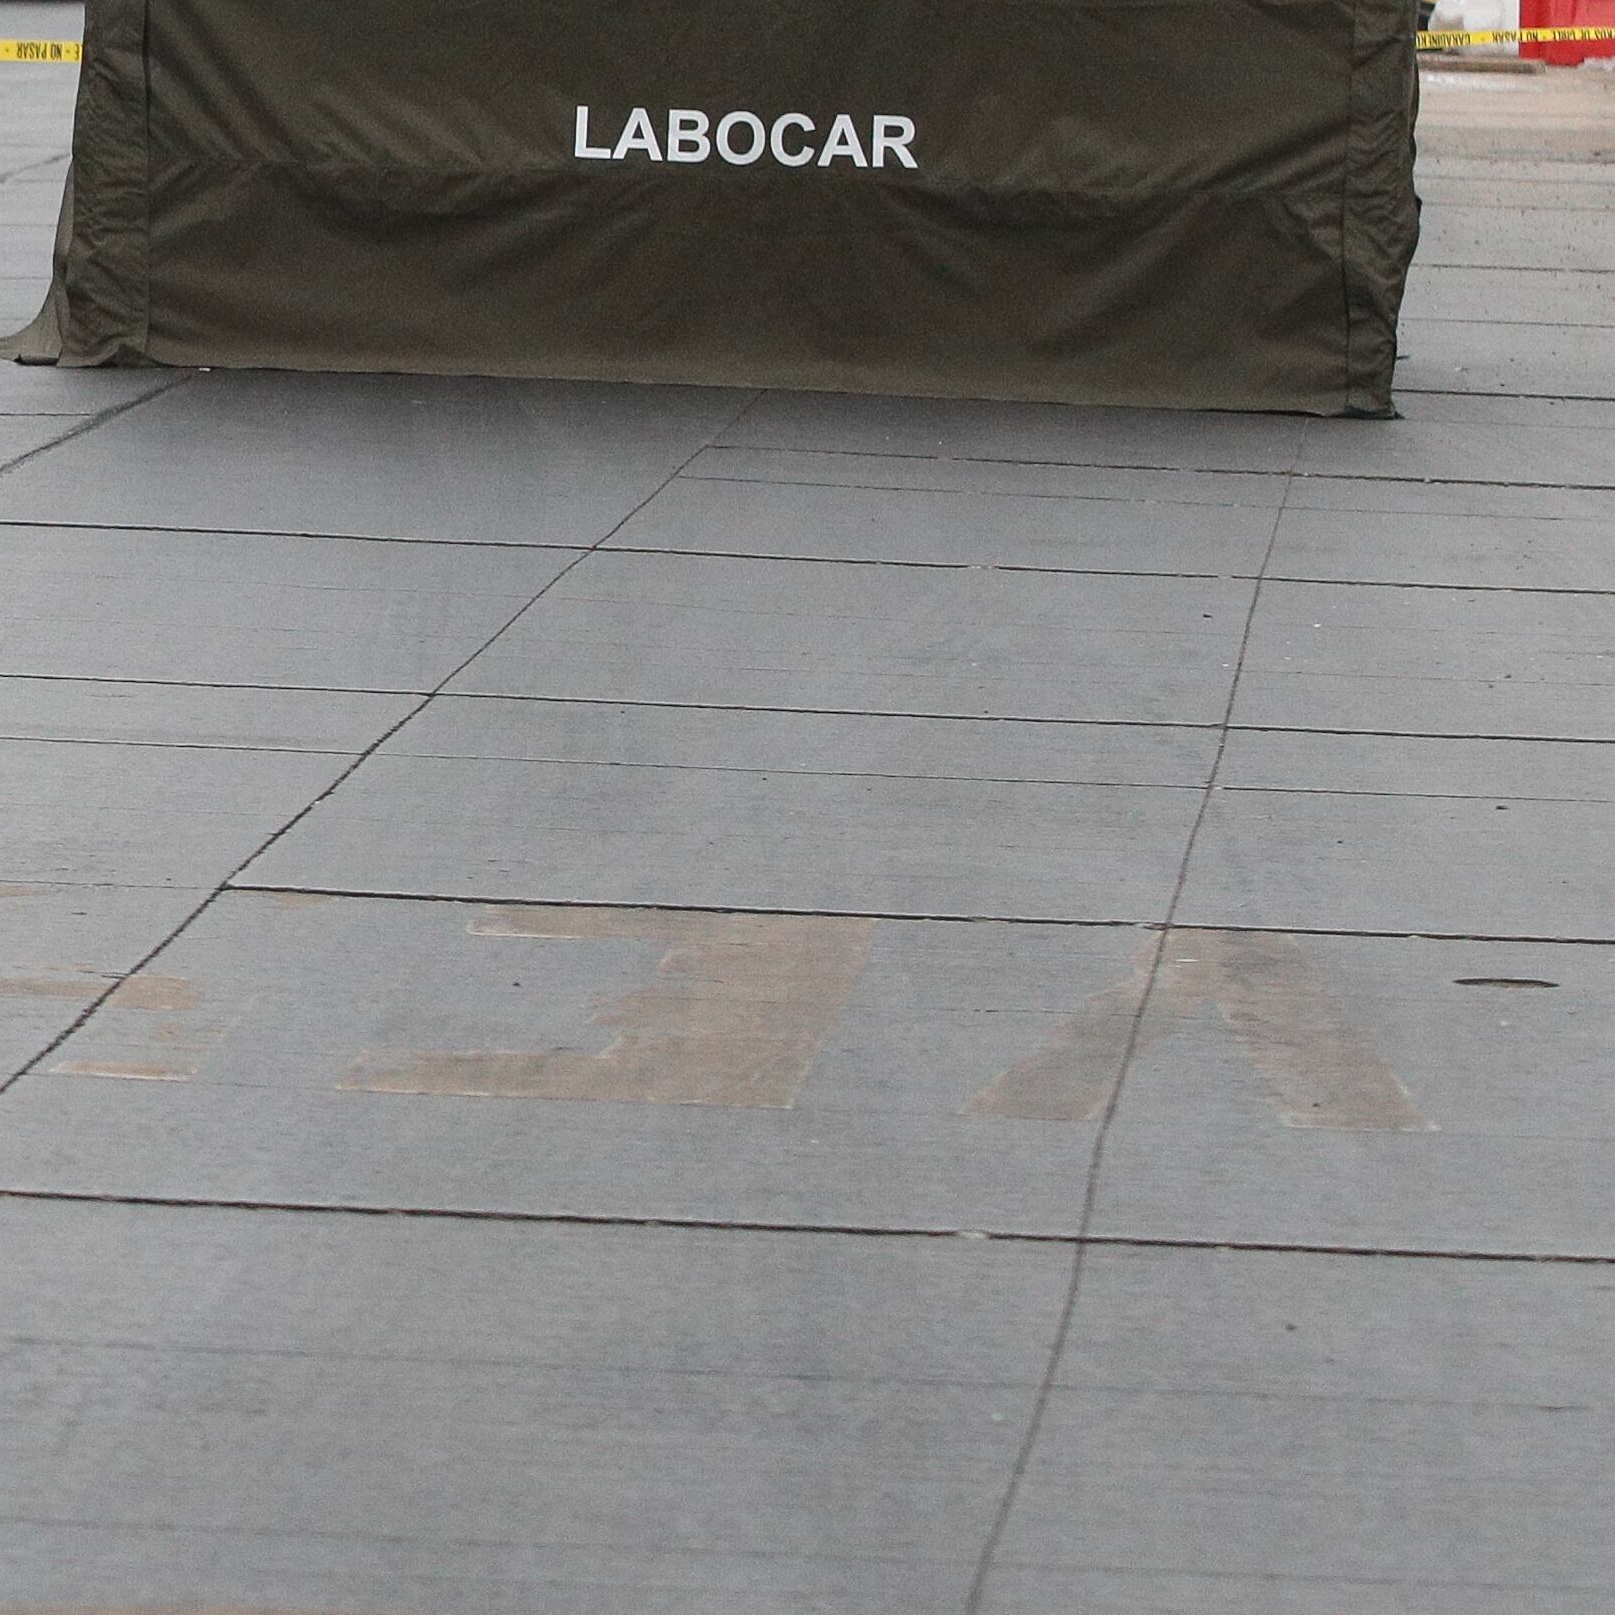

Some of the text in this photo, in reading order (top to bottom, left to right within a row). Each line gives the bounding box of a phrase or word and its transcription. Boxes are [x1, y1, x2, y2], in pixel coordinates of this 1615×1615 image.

[16, 42, 48, 60] PASAR
[50, 43, 63, 60] NO
[574, 105, 919, 169] LABOCAR
